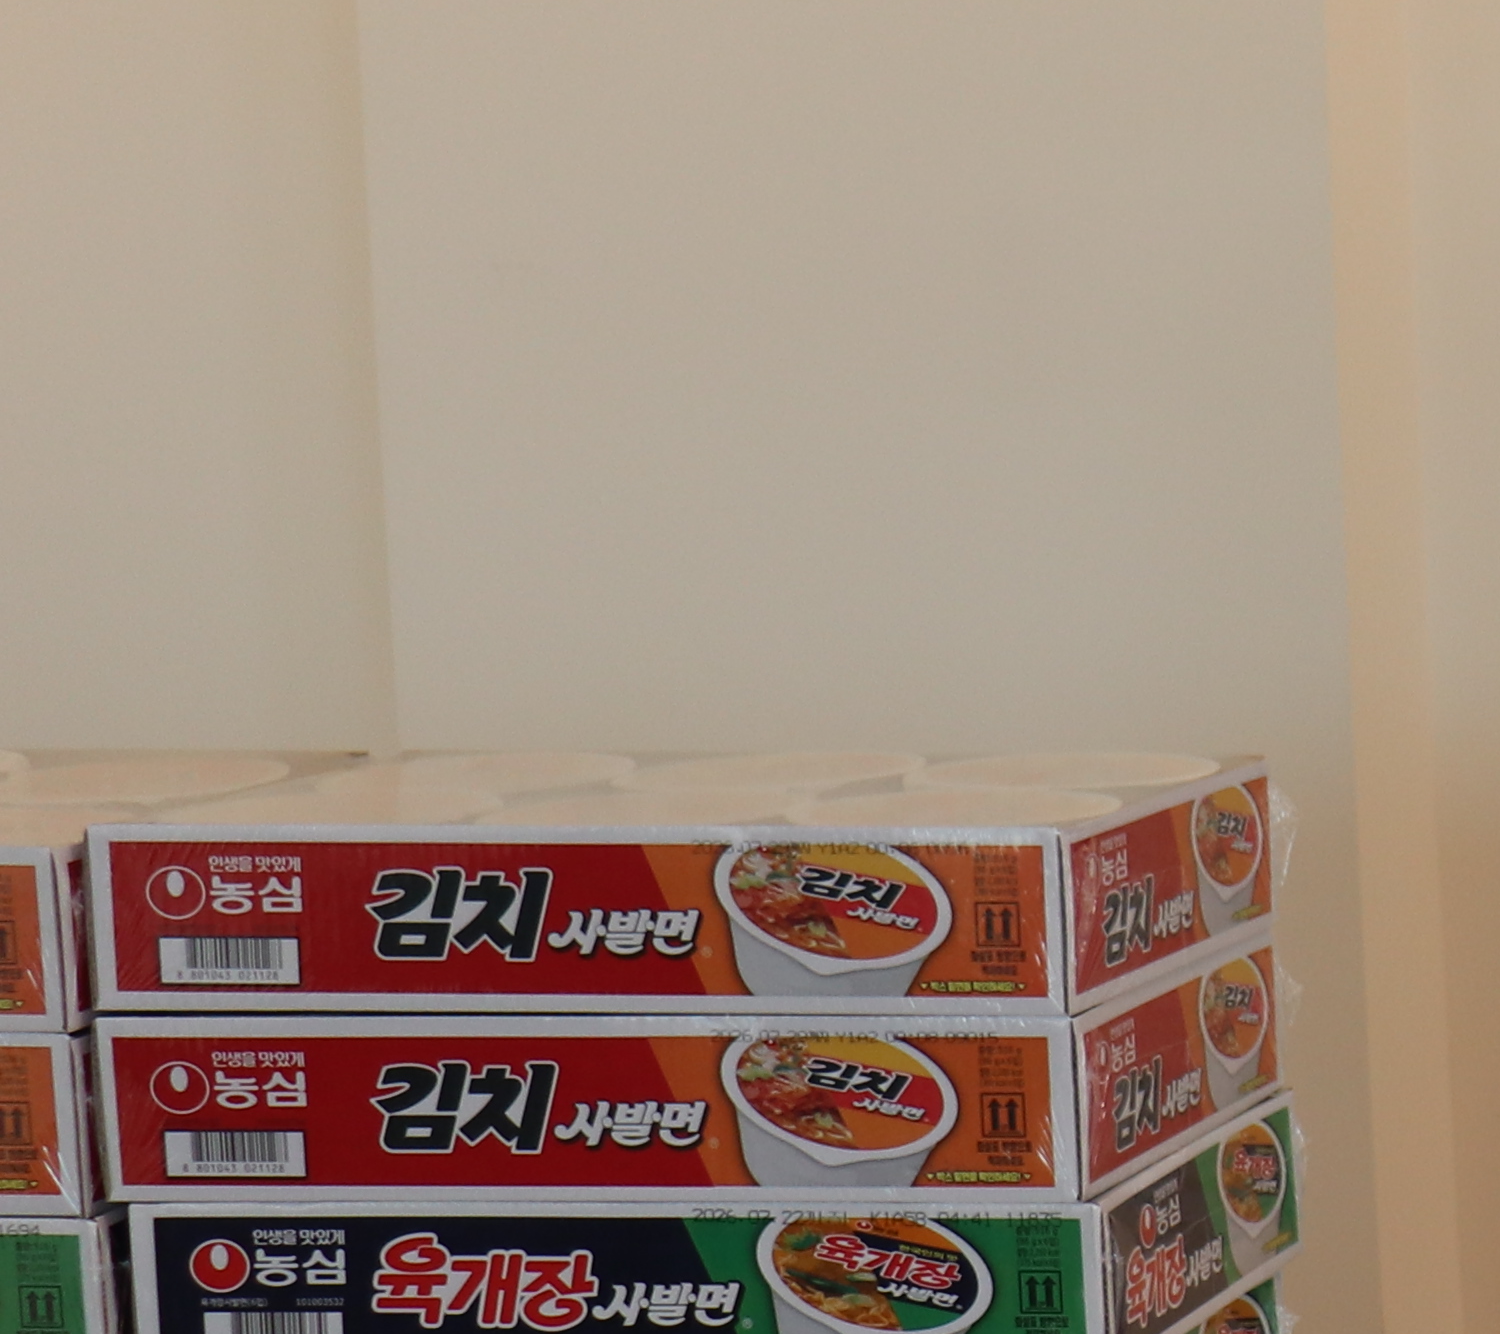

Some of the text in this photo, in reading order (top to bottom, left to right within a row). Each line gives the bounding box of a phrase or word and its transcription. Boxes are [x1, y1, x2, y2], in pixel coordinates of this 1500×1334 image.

[1102, 848, 1129, 886] 농심
[209, 873, 301, 912] 농심
[363, 865, 698, 962] 김치 사발면
[1102, 872, 1155, 968] 김치
[1155, 1193, 1182, 1235] 농심
[253, 1228, 345, 1244] 인생을 맛있게
[253, 1247, 346, 1286] 농심
[371, 1231, 739, 1331] 육개장 사발면
[1126, 1232, 1188, 1329] 육개장
